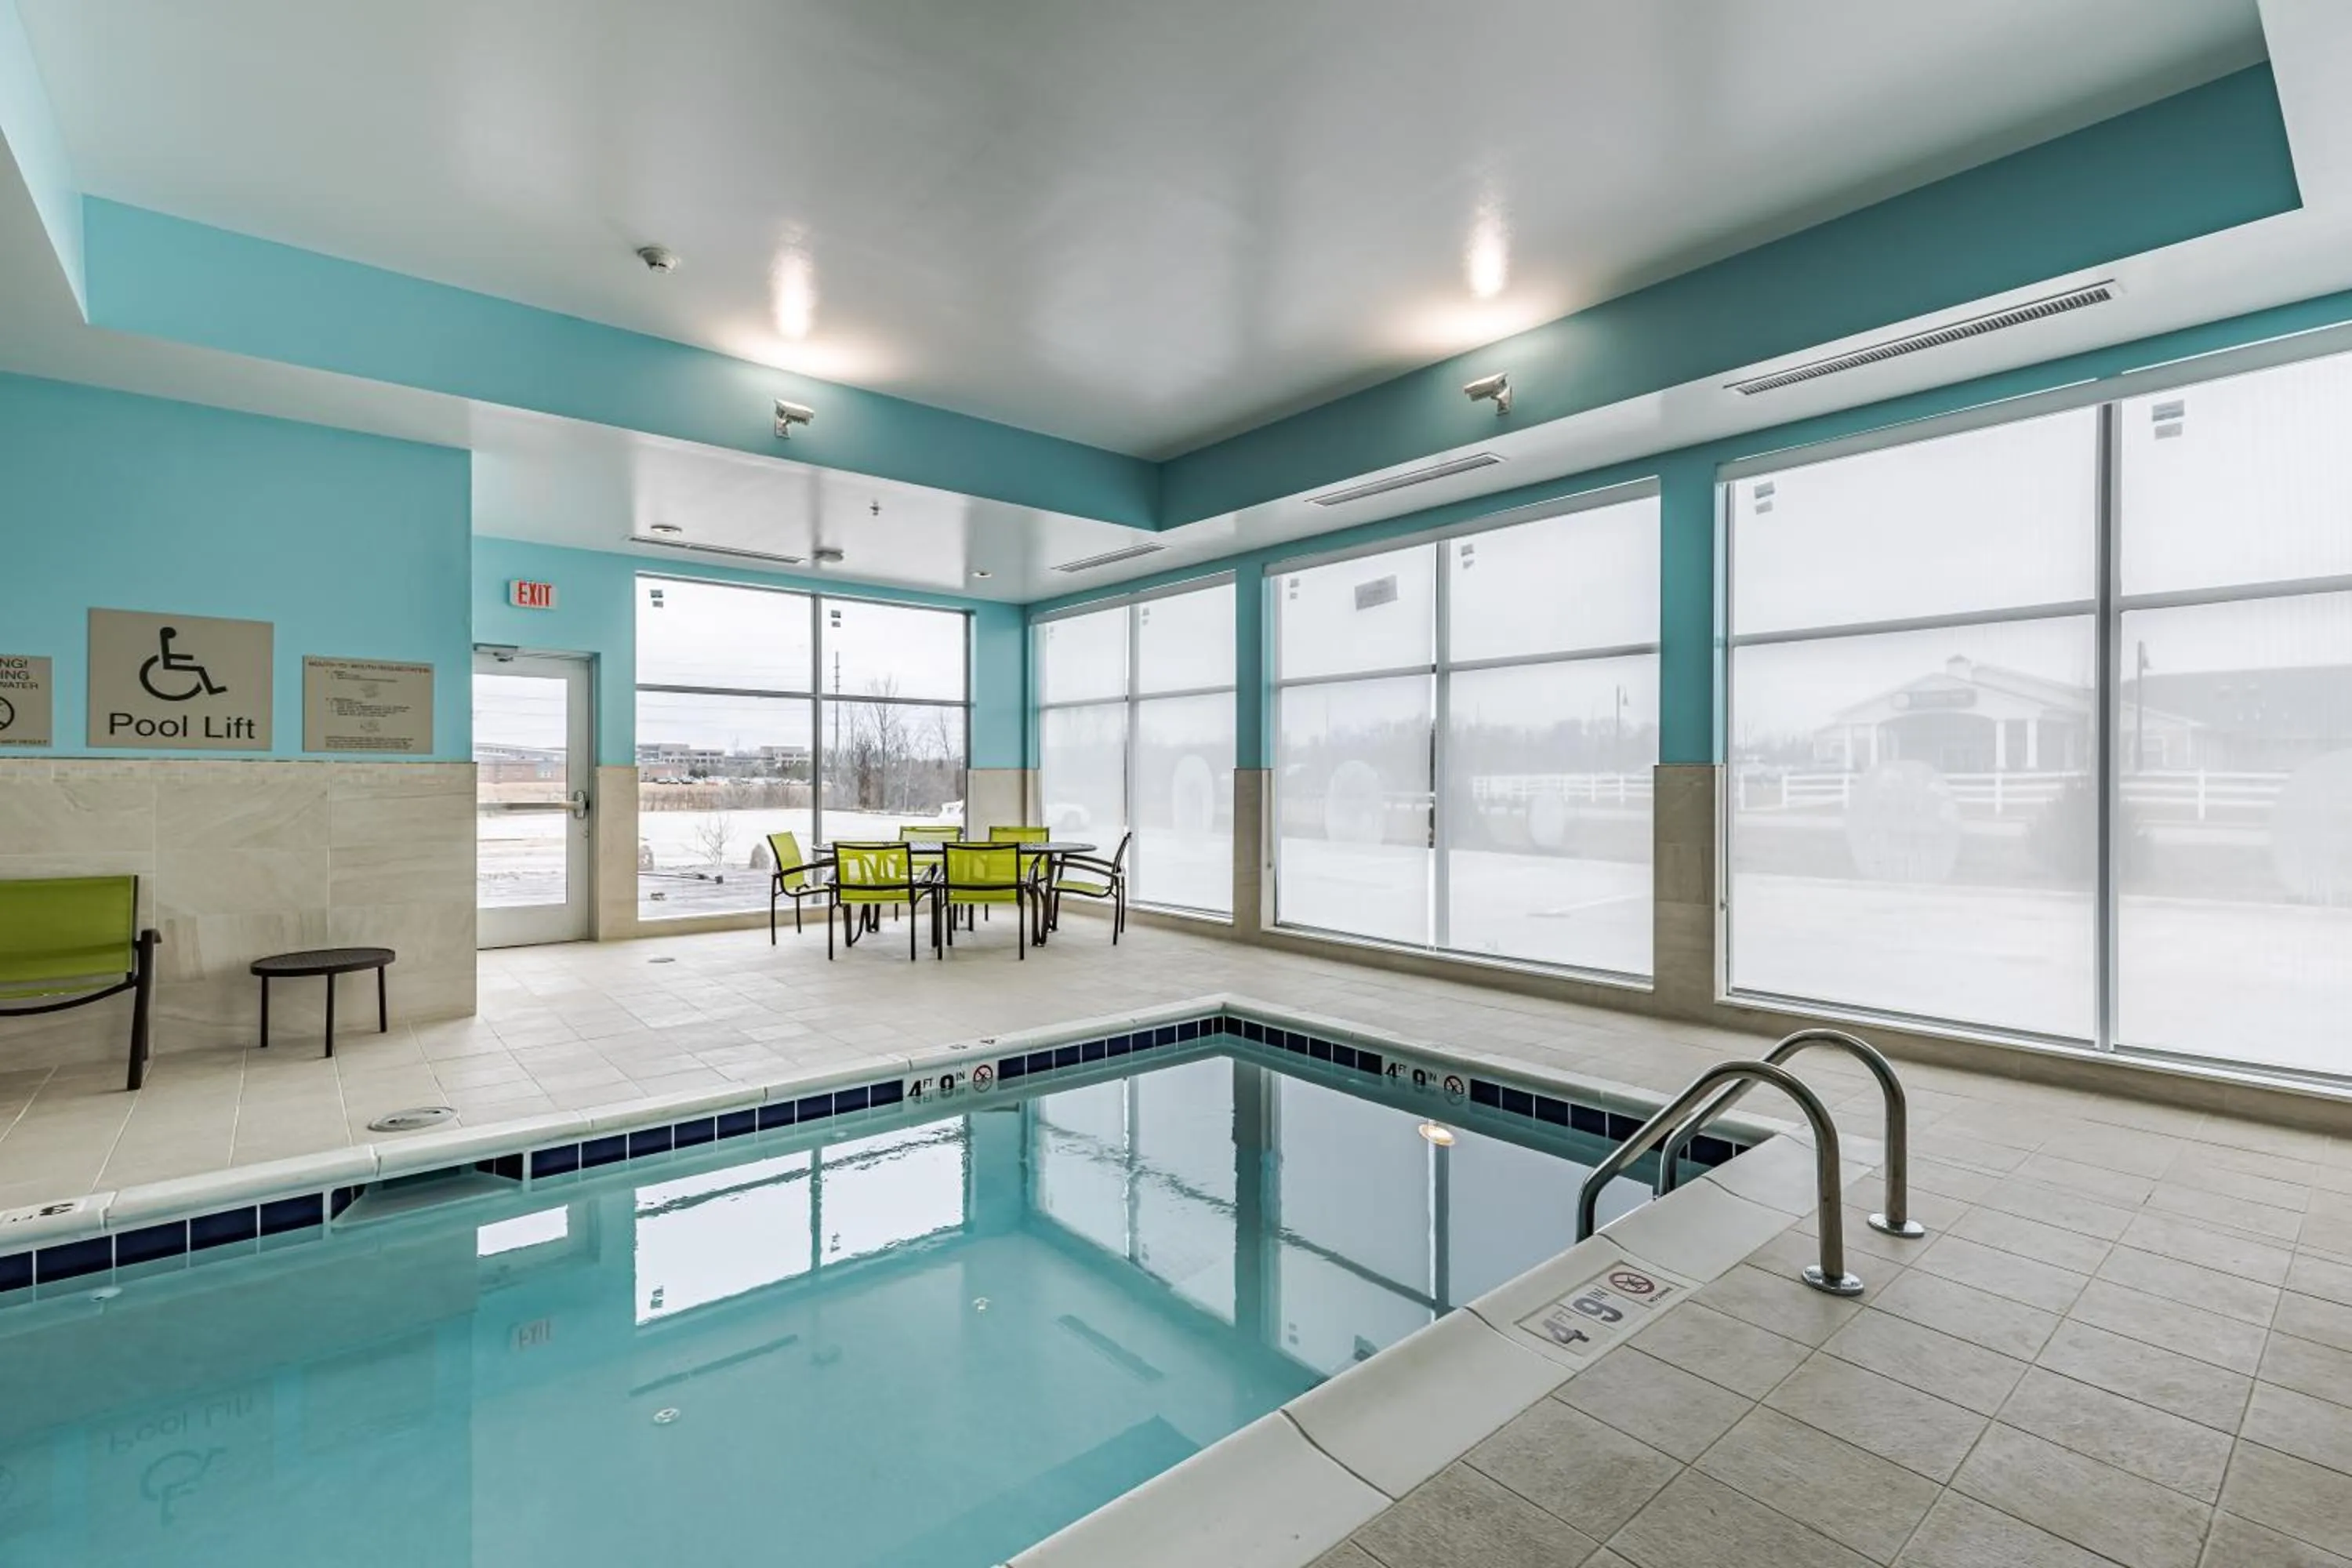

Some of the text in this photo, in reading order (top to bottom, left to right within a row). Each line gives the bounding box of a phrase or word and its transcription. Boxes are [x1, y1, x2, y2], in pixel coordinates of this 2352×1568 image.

[518, 581, 552, 606] EXIT
[108, 713, 256, 739] Pool Lift
